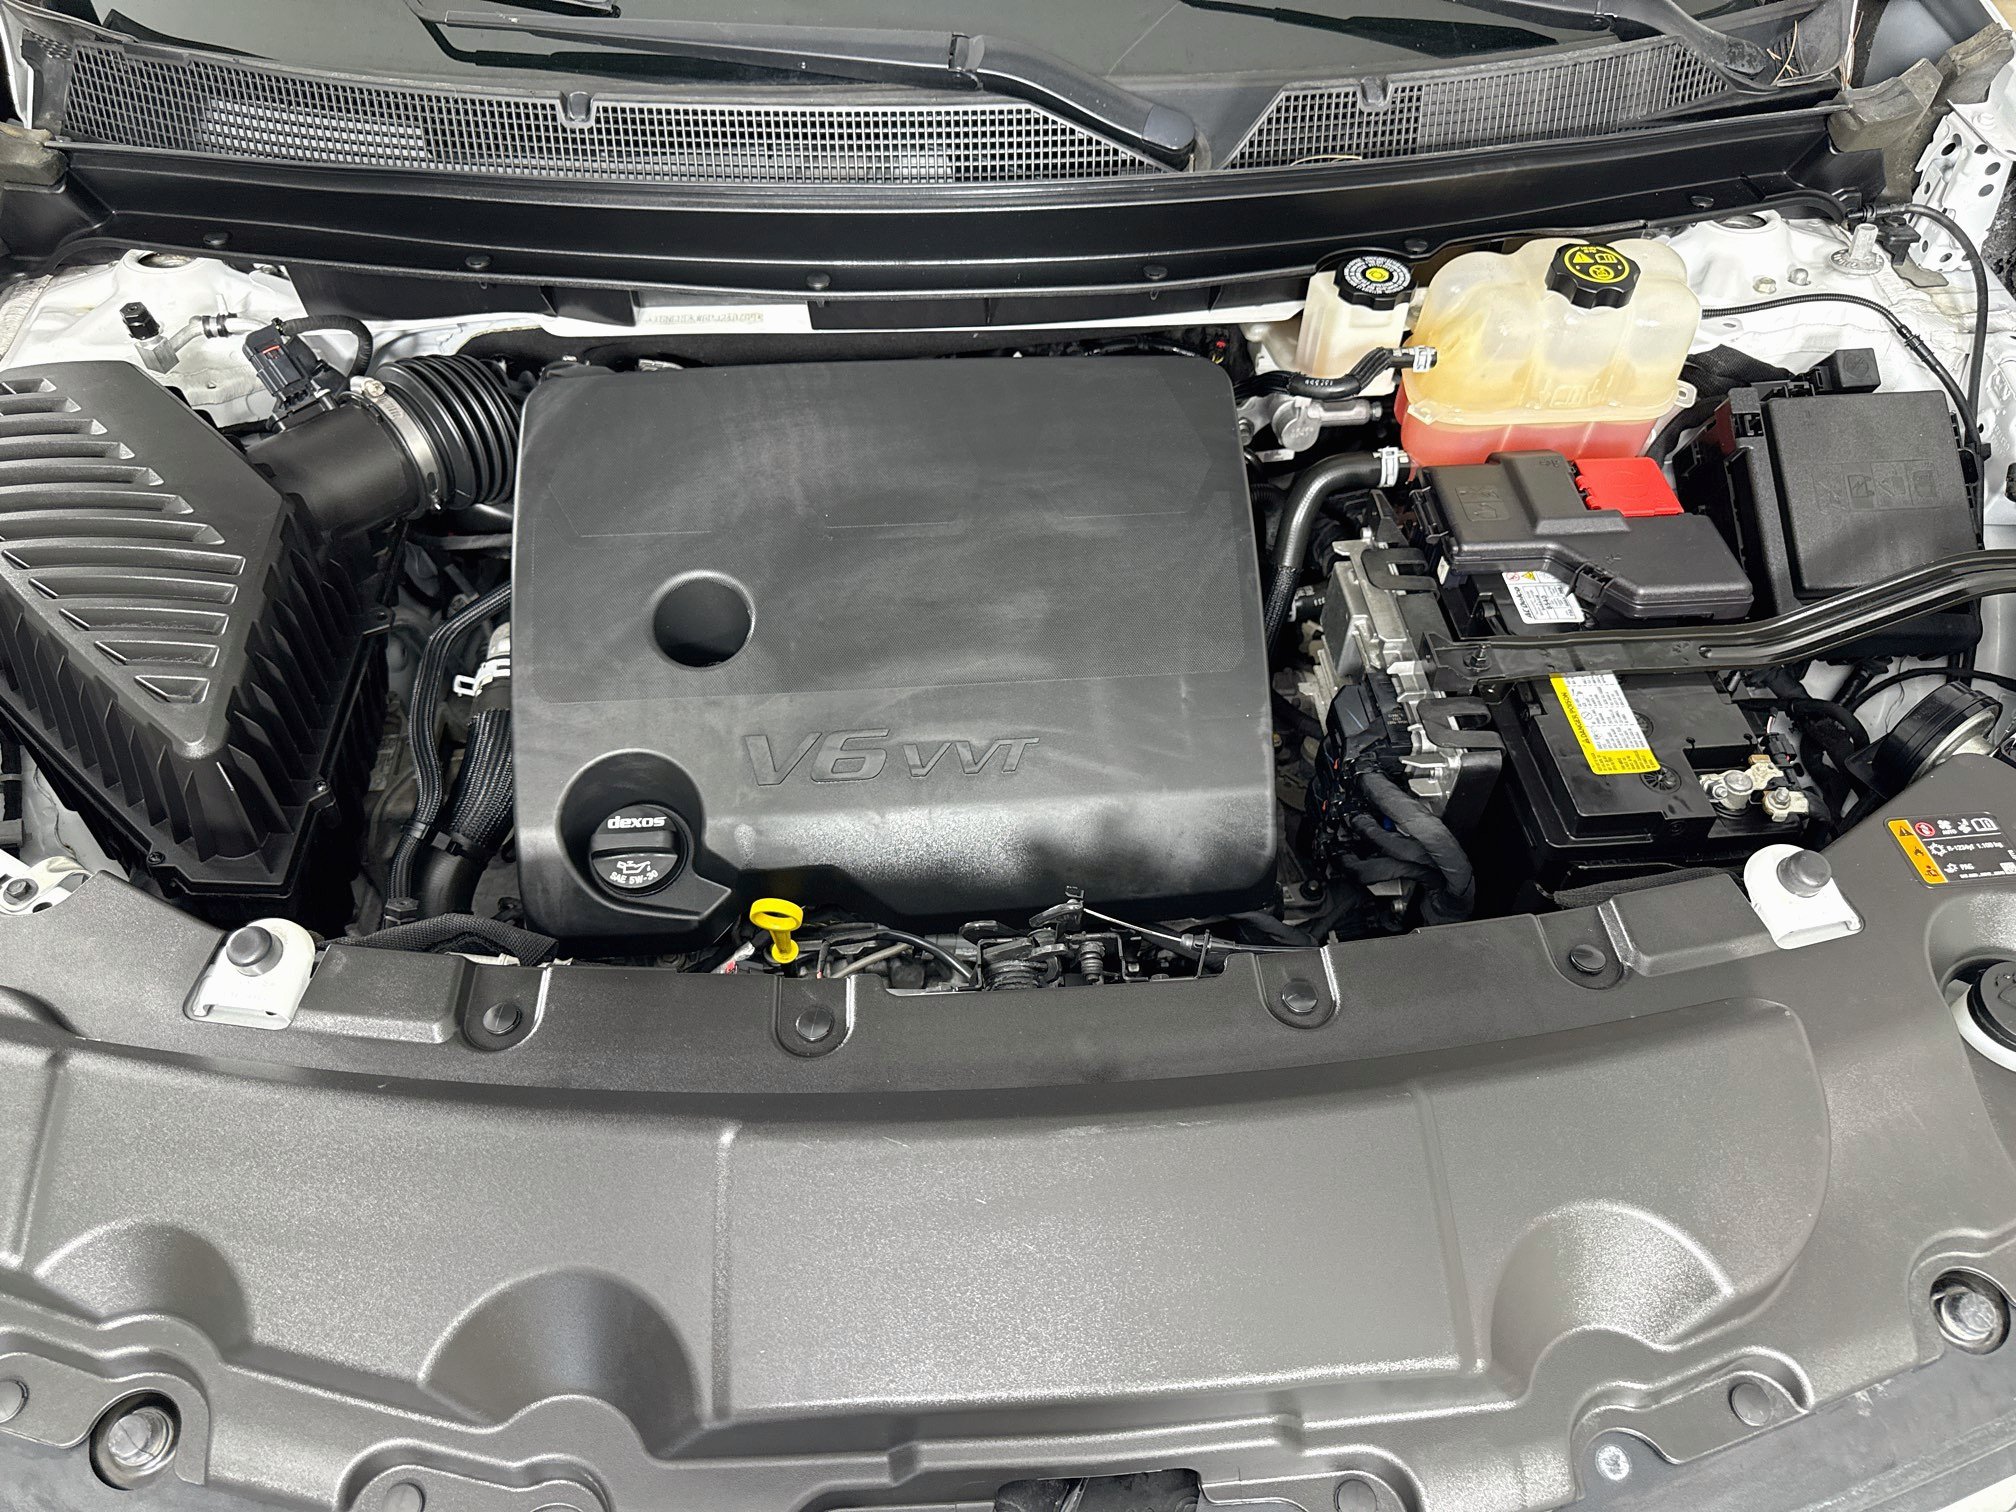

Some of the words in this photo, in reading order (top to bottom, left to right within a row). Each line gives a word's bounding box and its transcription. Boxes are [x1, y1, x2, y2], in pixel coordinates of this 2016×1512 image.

[745, 728, 890, 786] V6
[904, 737, 1039, 777] VVT
[607, 816, 668, 829] dexos
[610, 872, 626, 884] SAE
[629, 869, 659, 884] 5W-30
